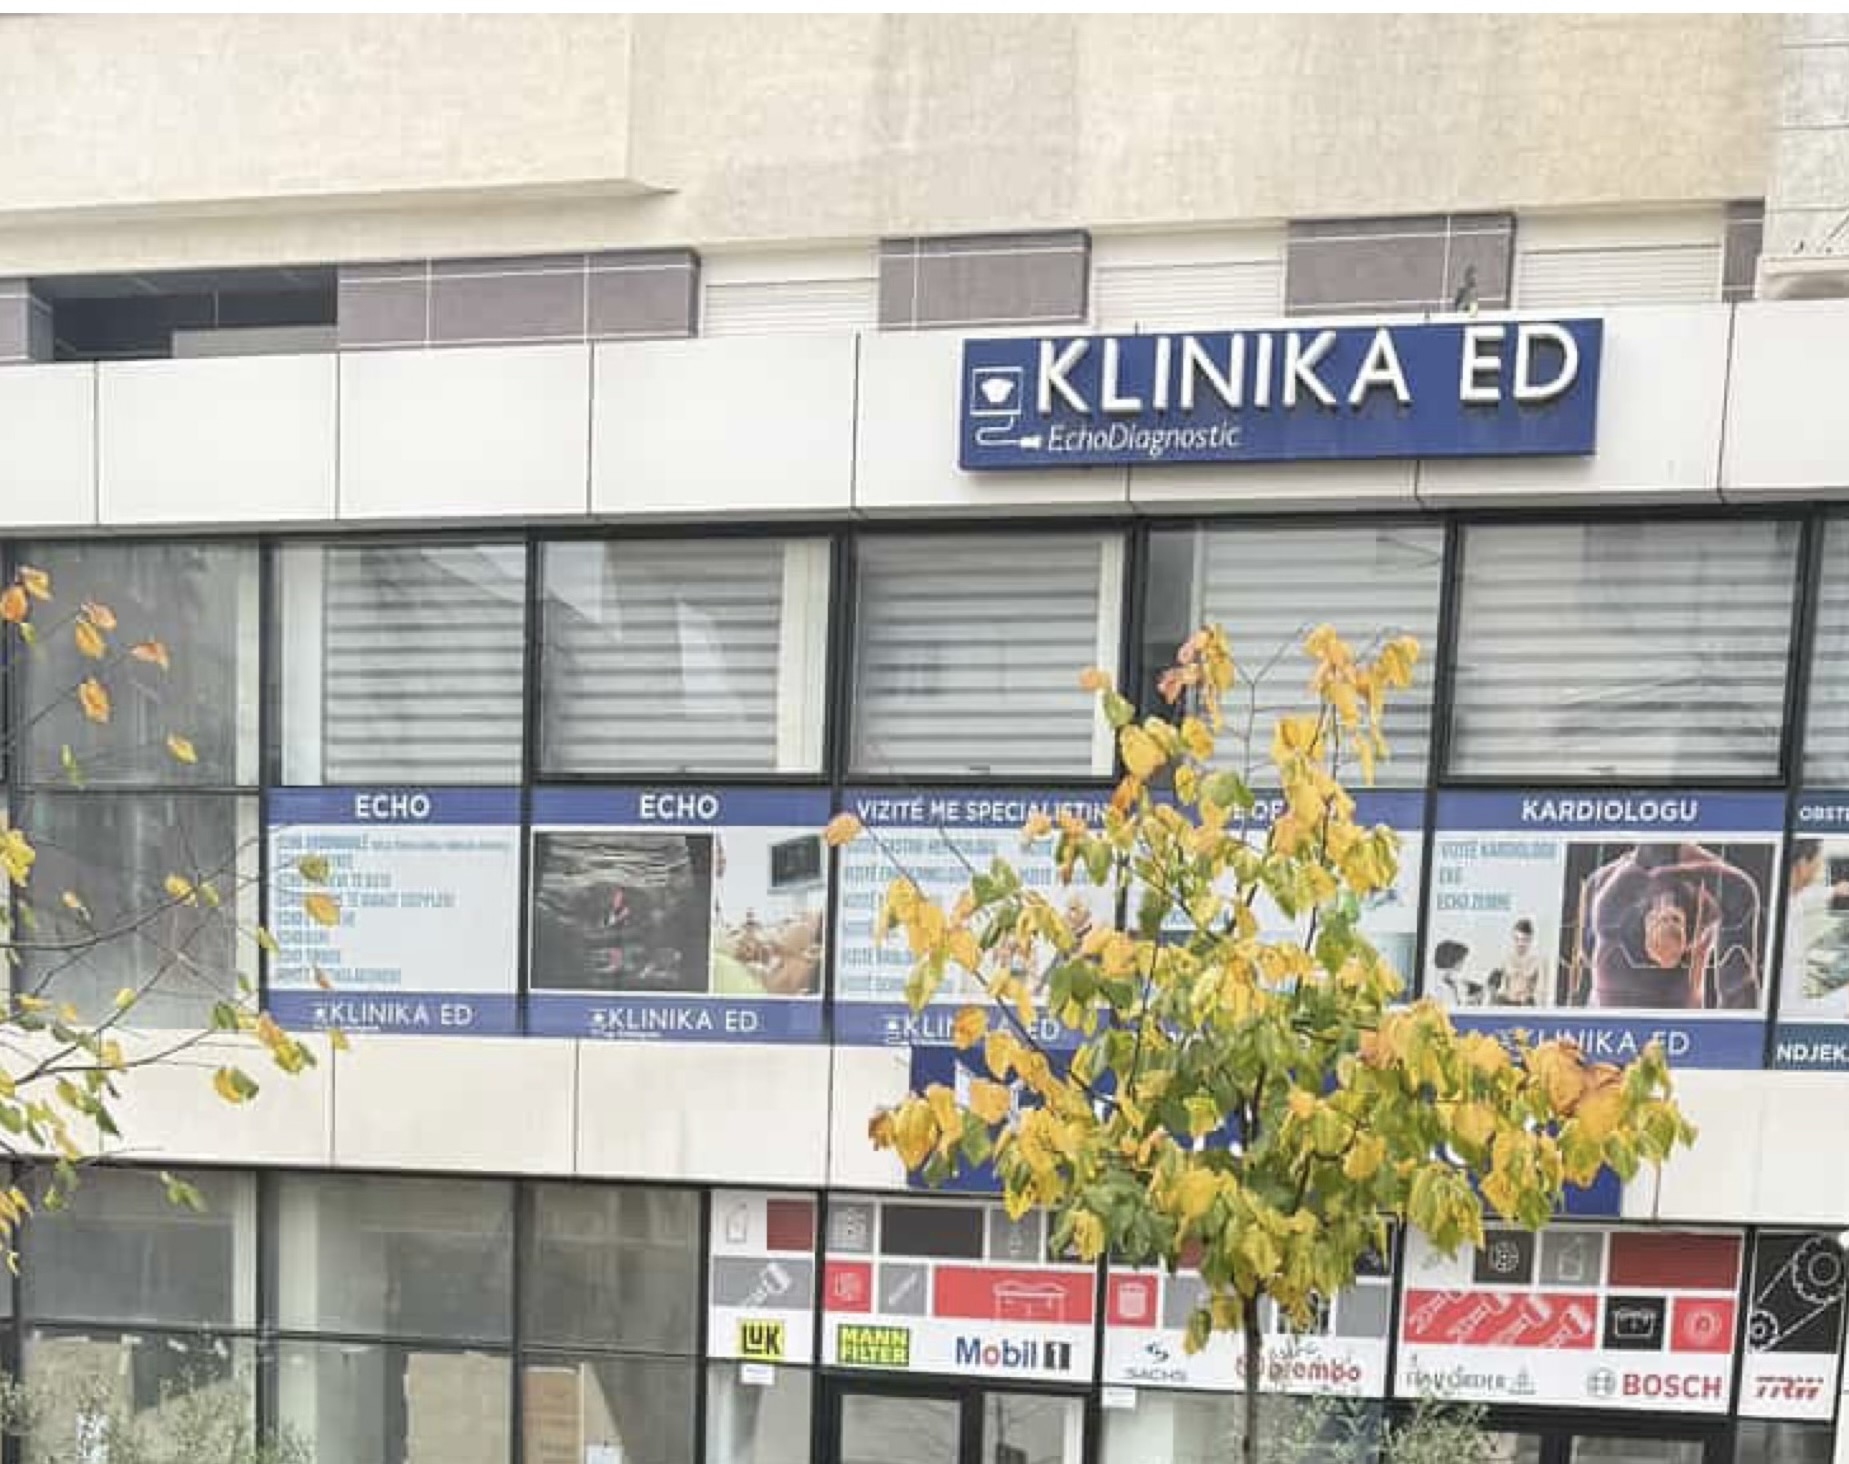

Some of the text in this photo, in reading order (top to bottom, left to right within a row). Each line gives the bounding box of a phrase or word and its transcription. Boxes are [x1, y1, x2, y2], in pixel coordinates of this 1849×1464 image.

[1036, 321, 1580, 413] KLINIKA ED
[1047, 424, 1240, 455] EchoDiagnostic
[355, 795, 430, 819] ECHO
[639, 795, 718, 820] ECHO
[1521, 799, 1698, 823] KARDIOLOGU
[328, 1005, 473, 1026] KLINIKA ED
[607, 1009, 758, 1033] KLINIKA ED
[842, 1327, 907, 1345] MANN
[842, 1345, 906, 1363] FILTER
[956, 1336, 1037, 1367] Mobil
[1622, 1373, 1723, 1399] BOSCH
[1755, 1376, 1825, 1401] TRW
